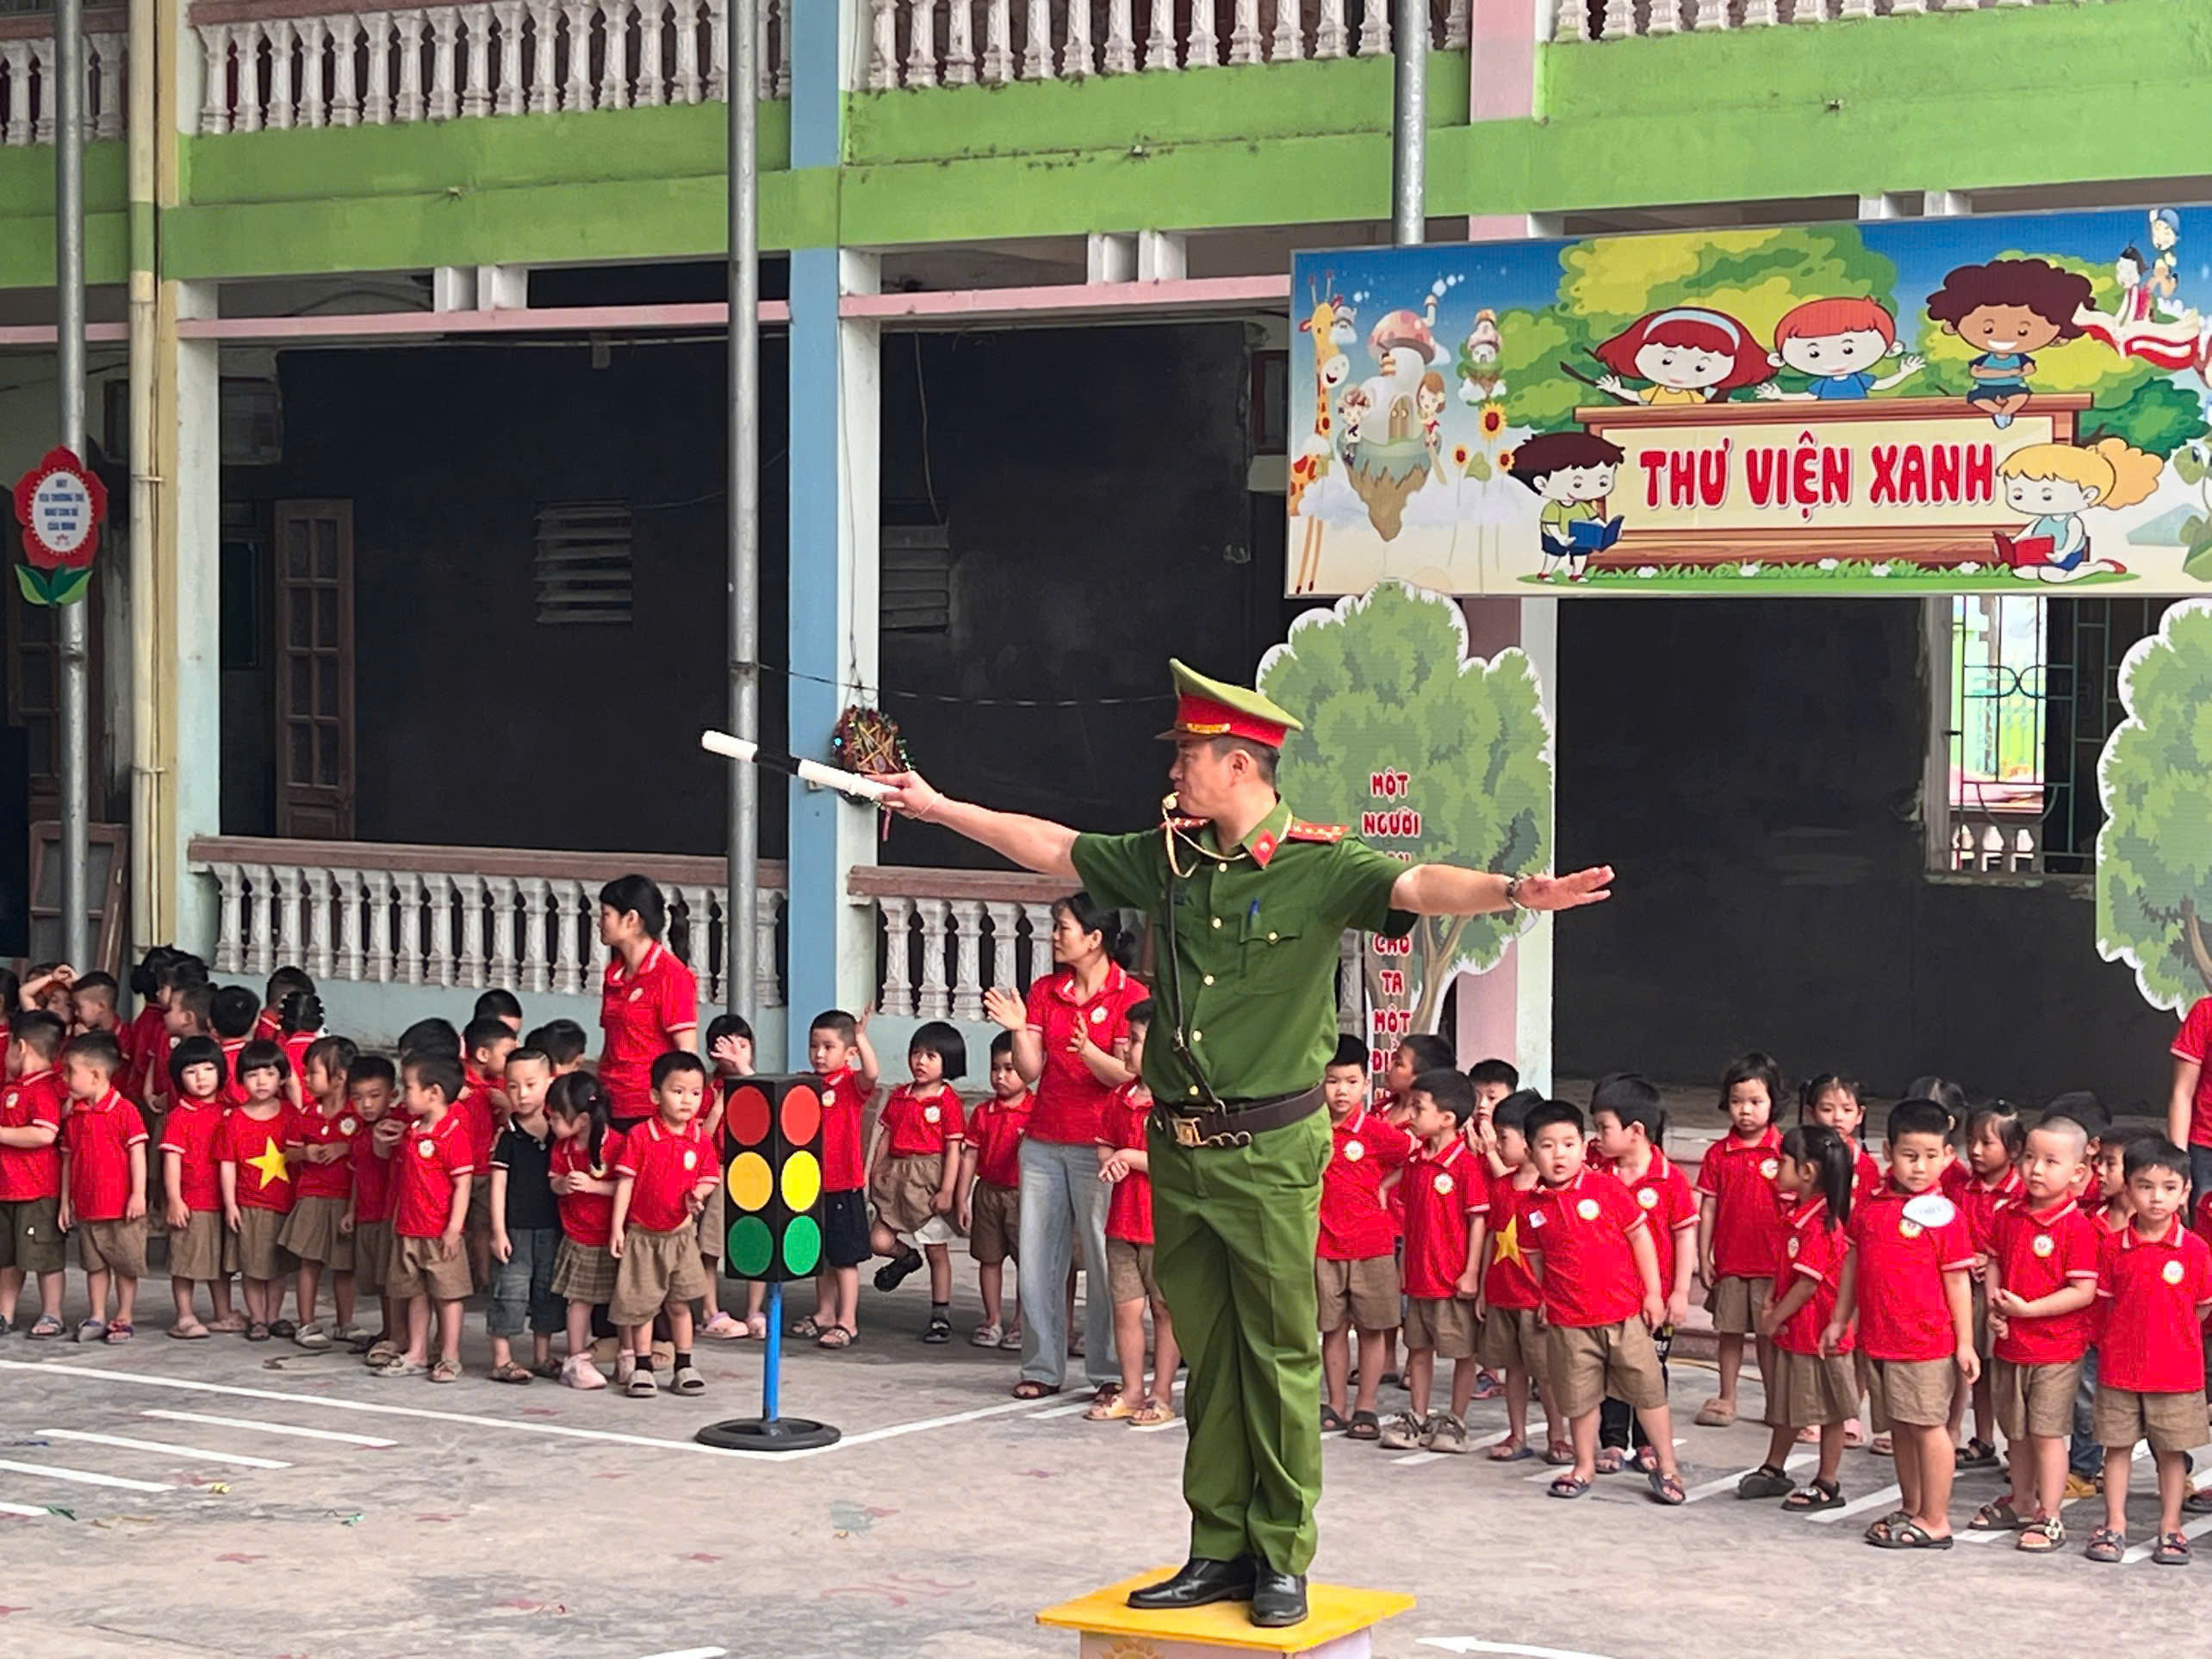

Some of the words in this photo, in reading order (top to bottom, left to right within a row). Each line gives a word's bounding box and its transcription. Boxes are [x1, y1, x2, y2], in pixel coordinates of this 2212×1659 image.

[1639, 437, 1730, 506] THƯ
[1745, 430, 1850, 519] VIỆN
[1869, 443, 1993, 504] XANH
[1371, 767, 1409, 802] MỘT
[1363, 806, 1420, 836] NGƯỜI
[1381, 971, 1403, 993] TA
[1373, 1004, 1411, 1037] MỘT
